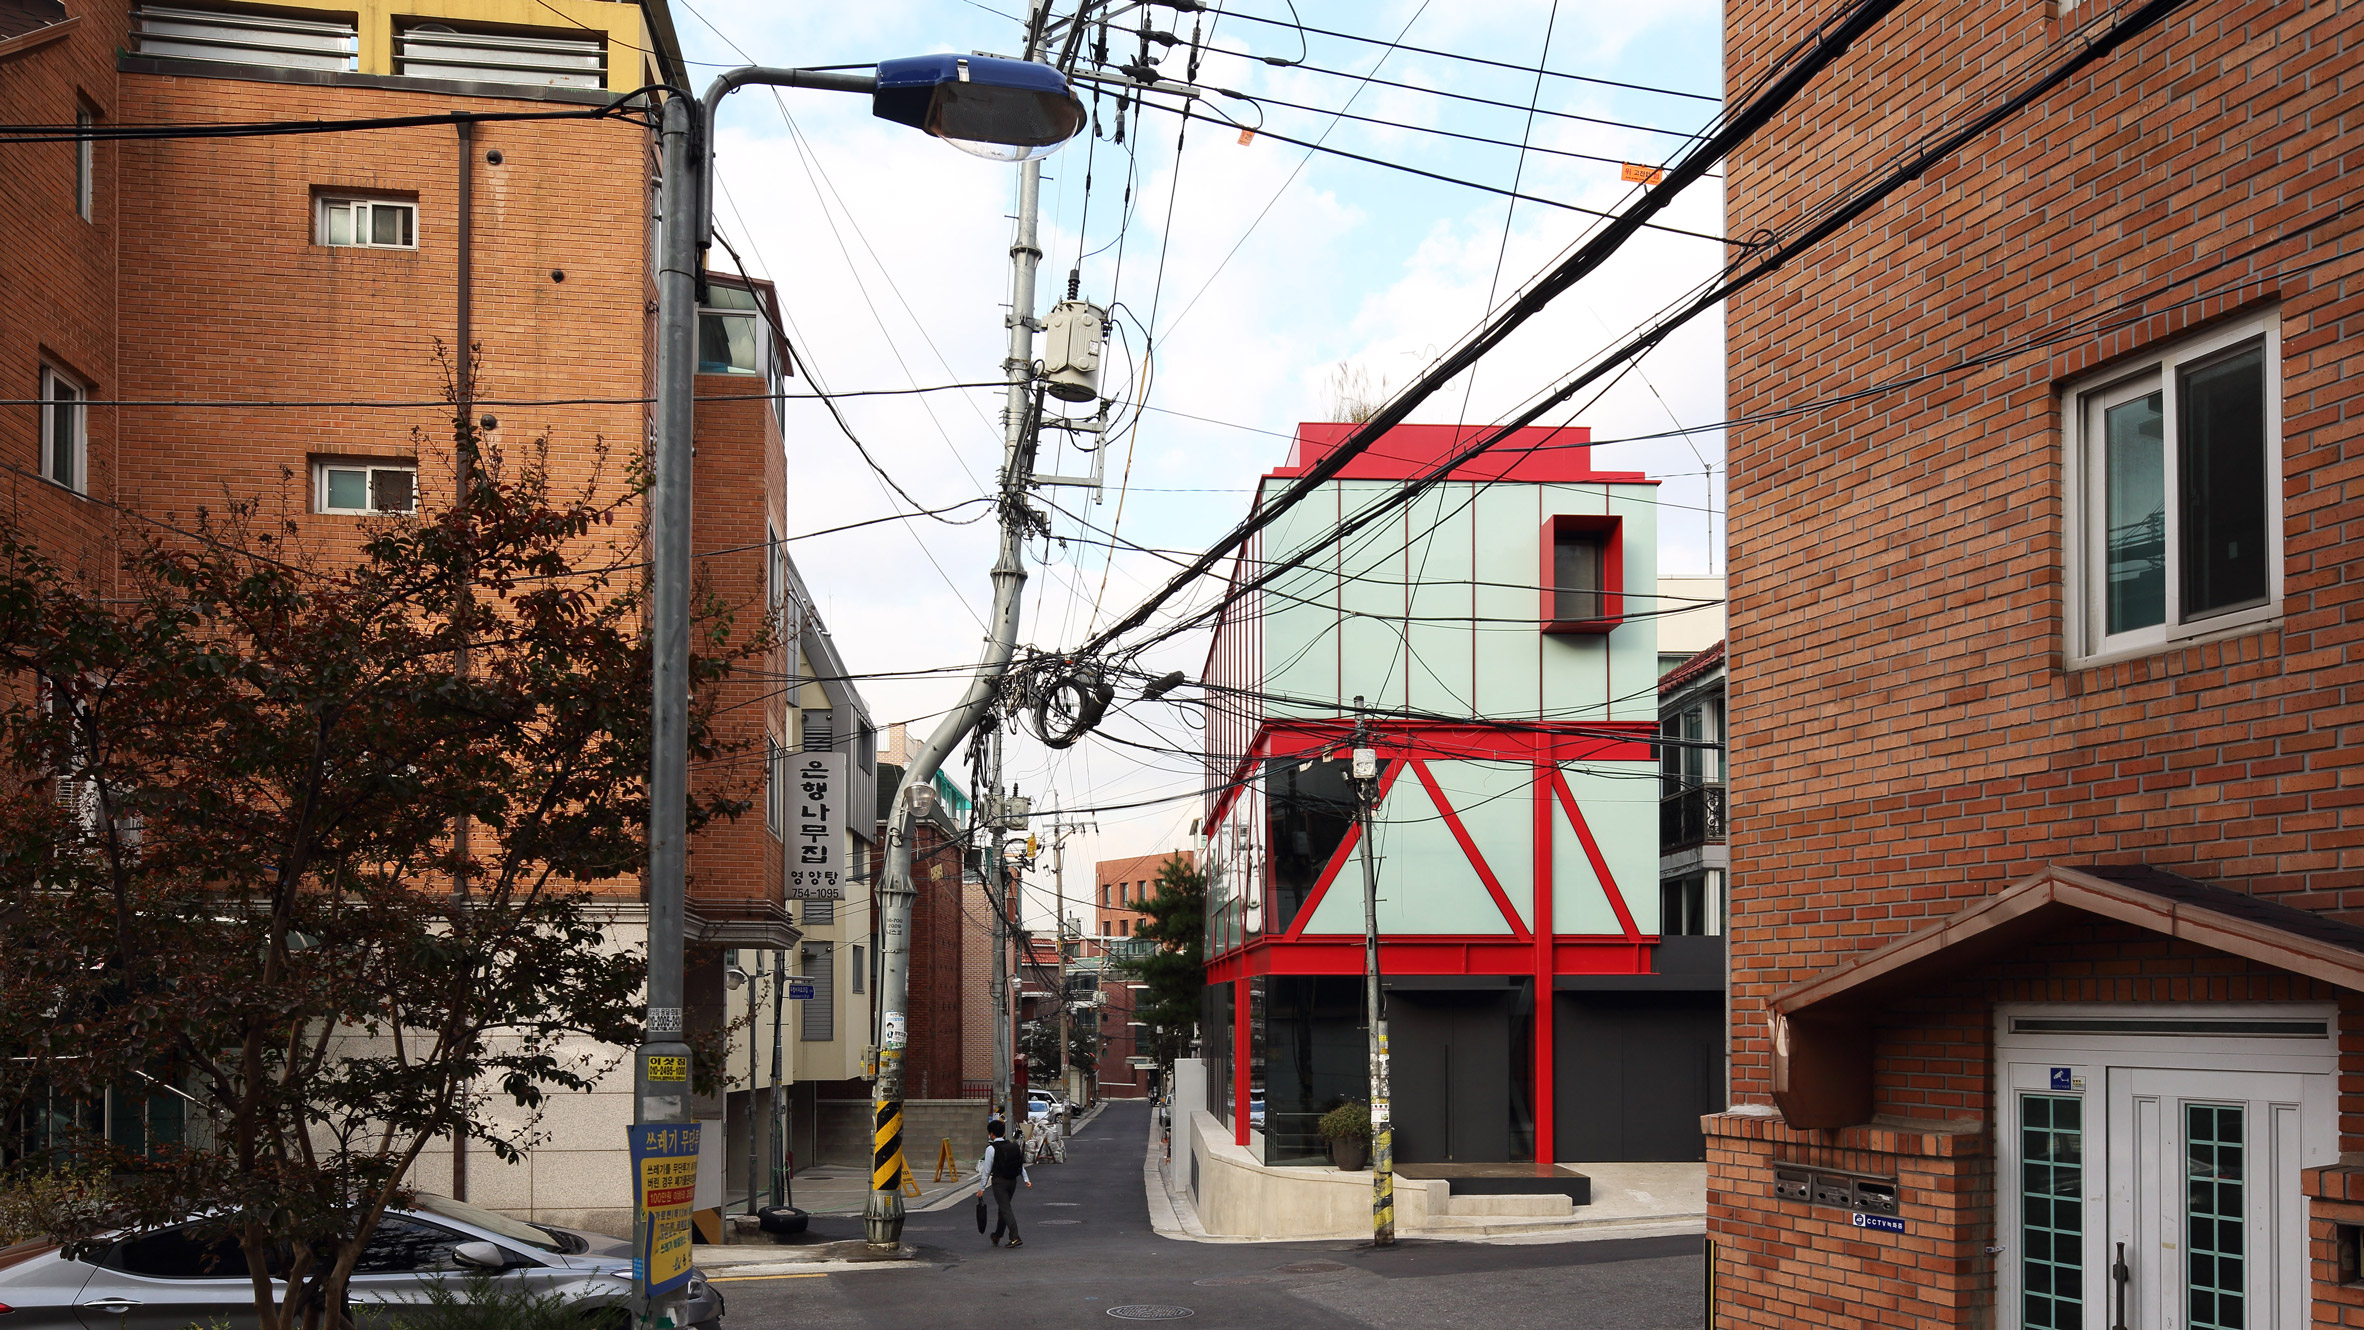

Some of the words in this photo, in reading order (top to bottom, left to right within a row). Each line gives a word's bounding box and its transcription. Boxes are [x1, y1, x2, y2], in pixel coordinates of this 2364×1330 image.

[799, 760, 831, 864] 은행나무집
[791, 870, 839, 886] 영양탕
[792, 888, 839, 898] 754-1095
[646, 1129, 677, 1153] 쓰레기
[647, 1177, 659, 1188] 버린
[662, 1176, 673, 1188] 경우
